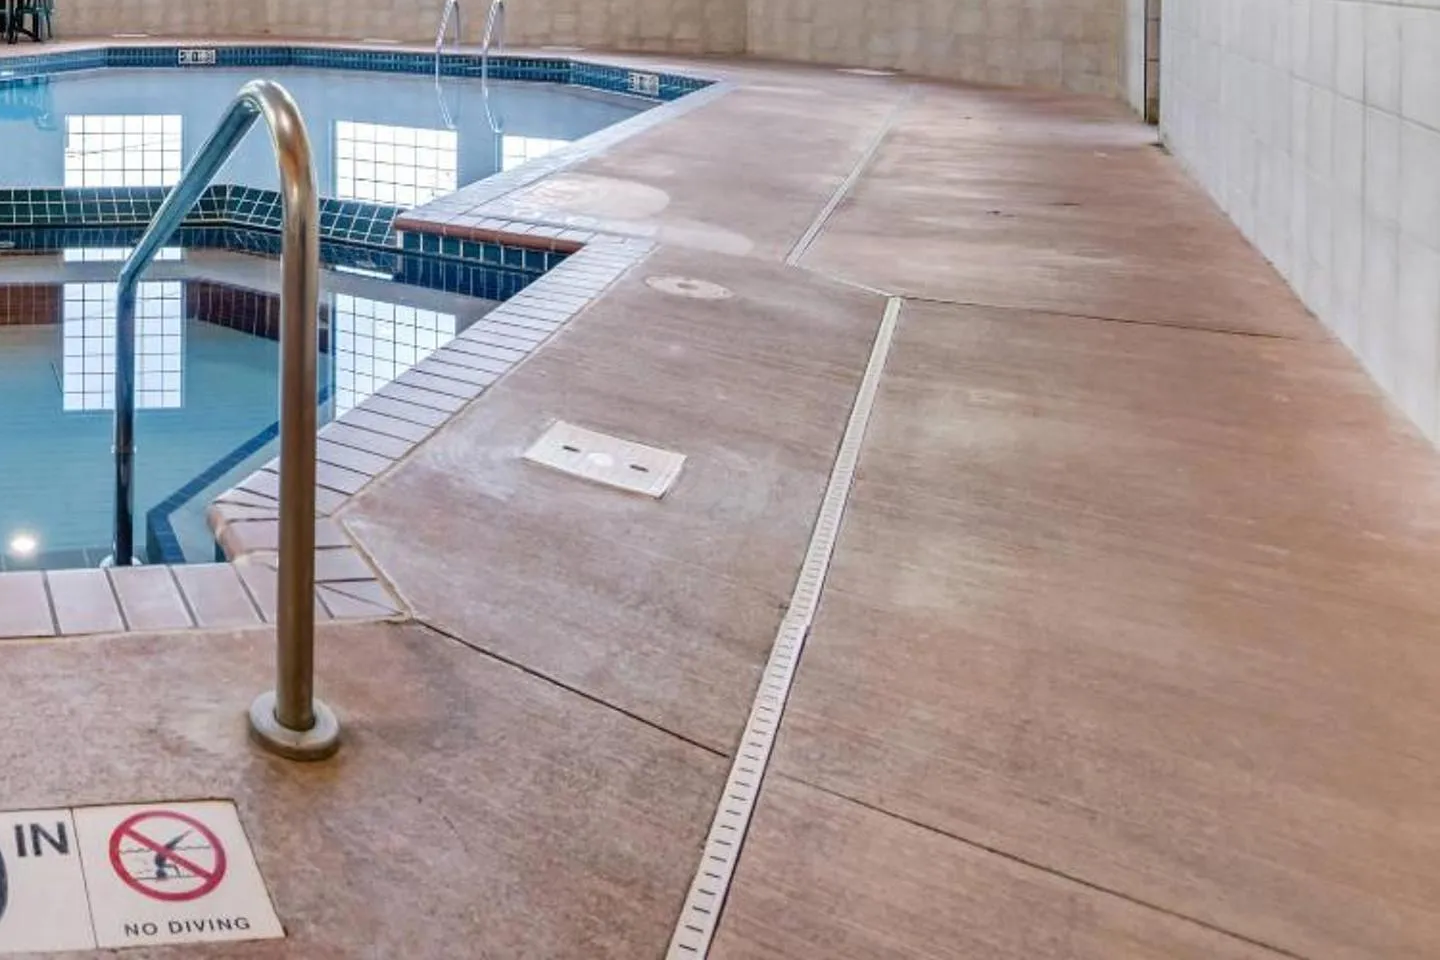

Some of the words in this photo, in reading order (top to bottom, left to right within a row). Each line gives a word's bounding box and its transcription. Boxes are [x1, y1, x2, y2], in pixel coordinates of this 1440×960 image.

[14, 821, 69, 858] IN
[123, 922, 159, 937] NO
[167, 916, 251, 935] DIVING
